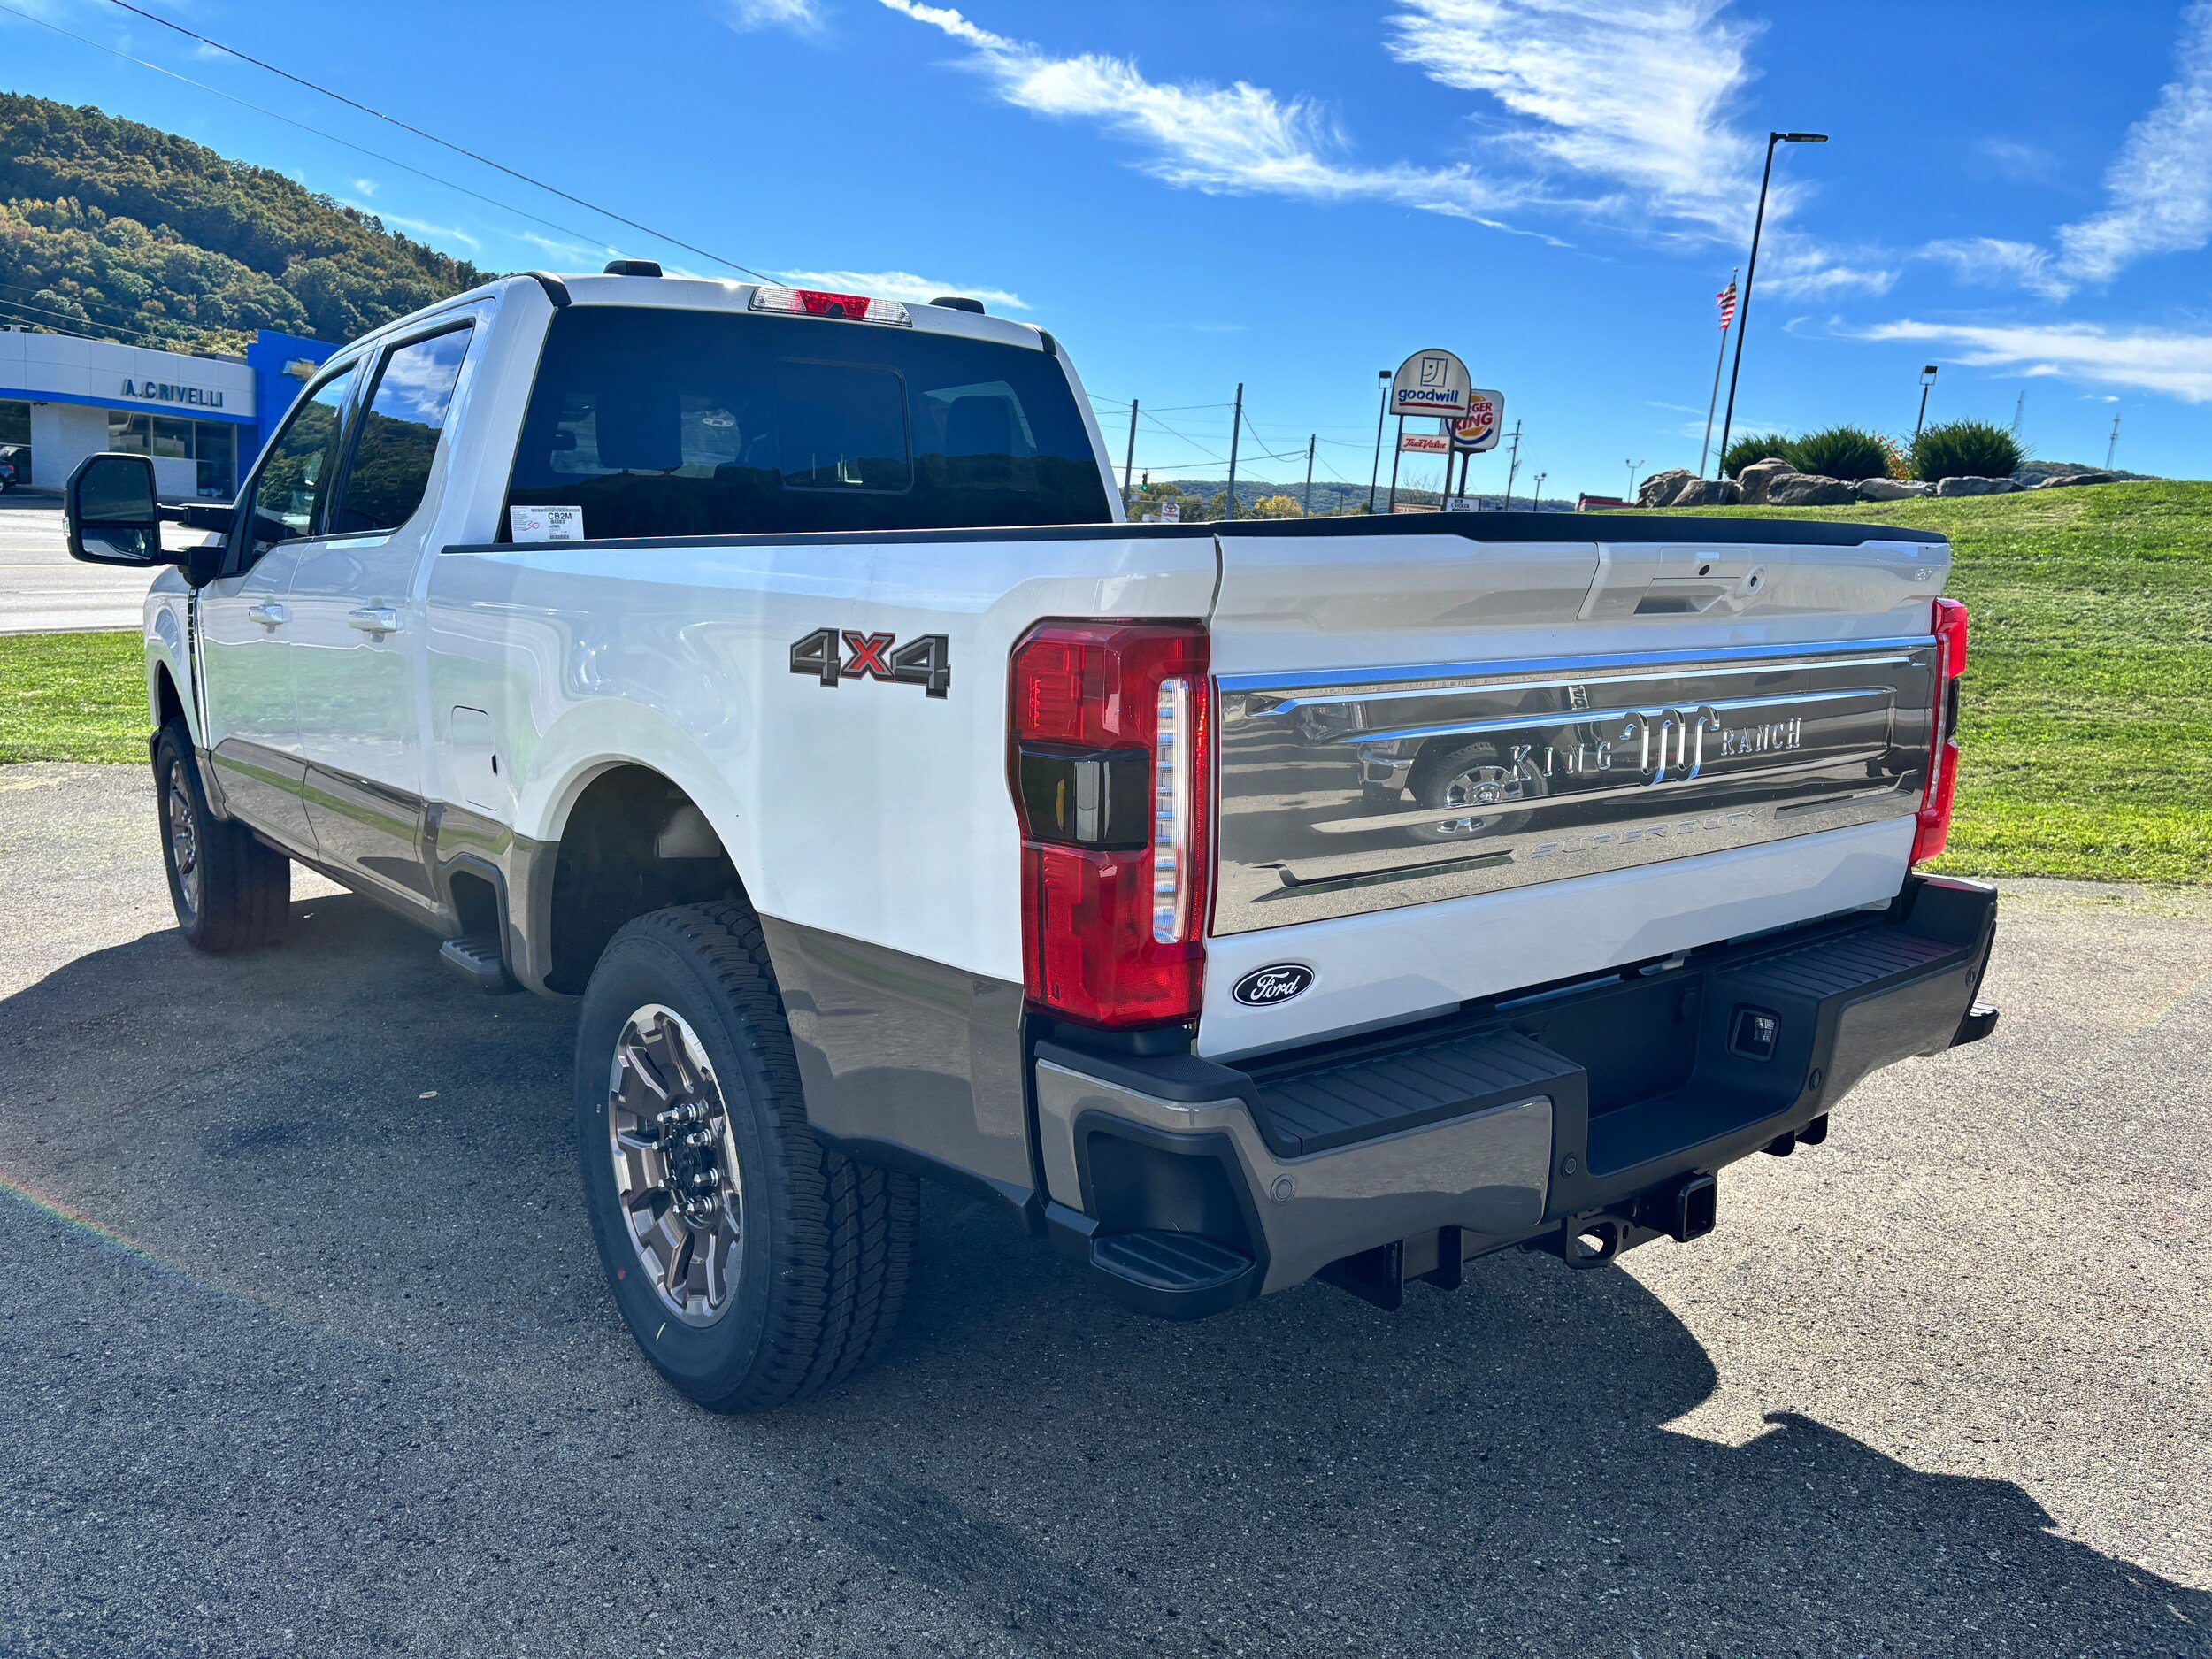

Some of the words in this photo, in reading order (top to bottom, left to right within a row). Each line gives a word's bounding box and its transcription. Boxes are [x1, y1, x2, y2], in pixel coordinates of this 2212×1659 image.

[1398, 389, 1459, 403] goodwill
[1469, 402, 1493, 413] GER
[1403, 438, 1423, 448] True
[1419, 439, 1447, 449] Value
[1509, 741, 1612, 782] KING
[1720, 717, 1801, 757] RANCH
[1250, 972, 1301, 1001] Ford
